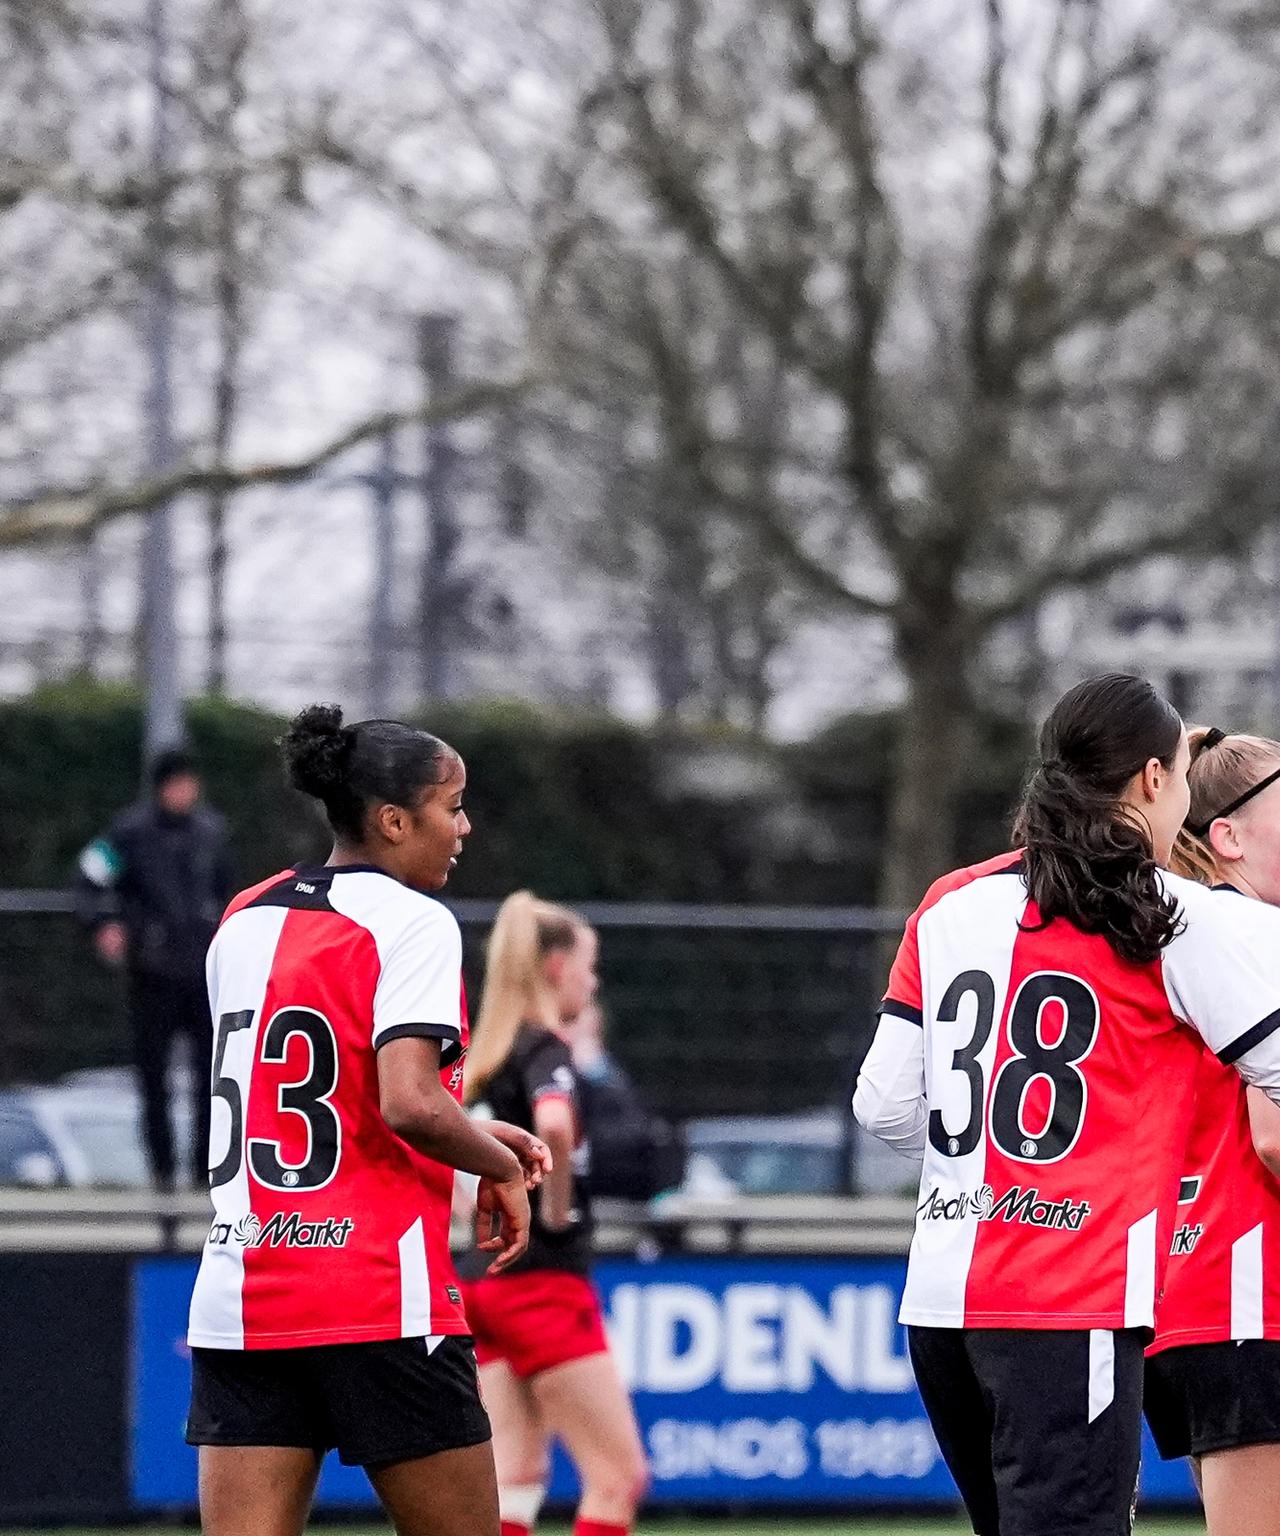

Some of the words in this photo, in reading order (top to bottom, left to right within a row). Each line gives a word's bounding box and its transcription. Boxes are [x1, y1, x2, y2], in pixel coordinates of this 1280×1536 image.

[208, 1006, 342, 1192] 53
[928, 969, 1100, 1164] 38
[255, 1211, 353, 1249] Markt
[985, 1185, 1092, 1231] Markt
